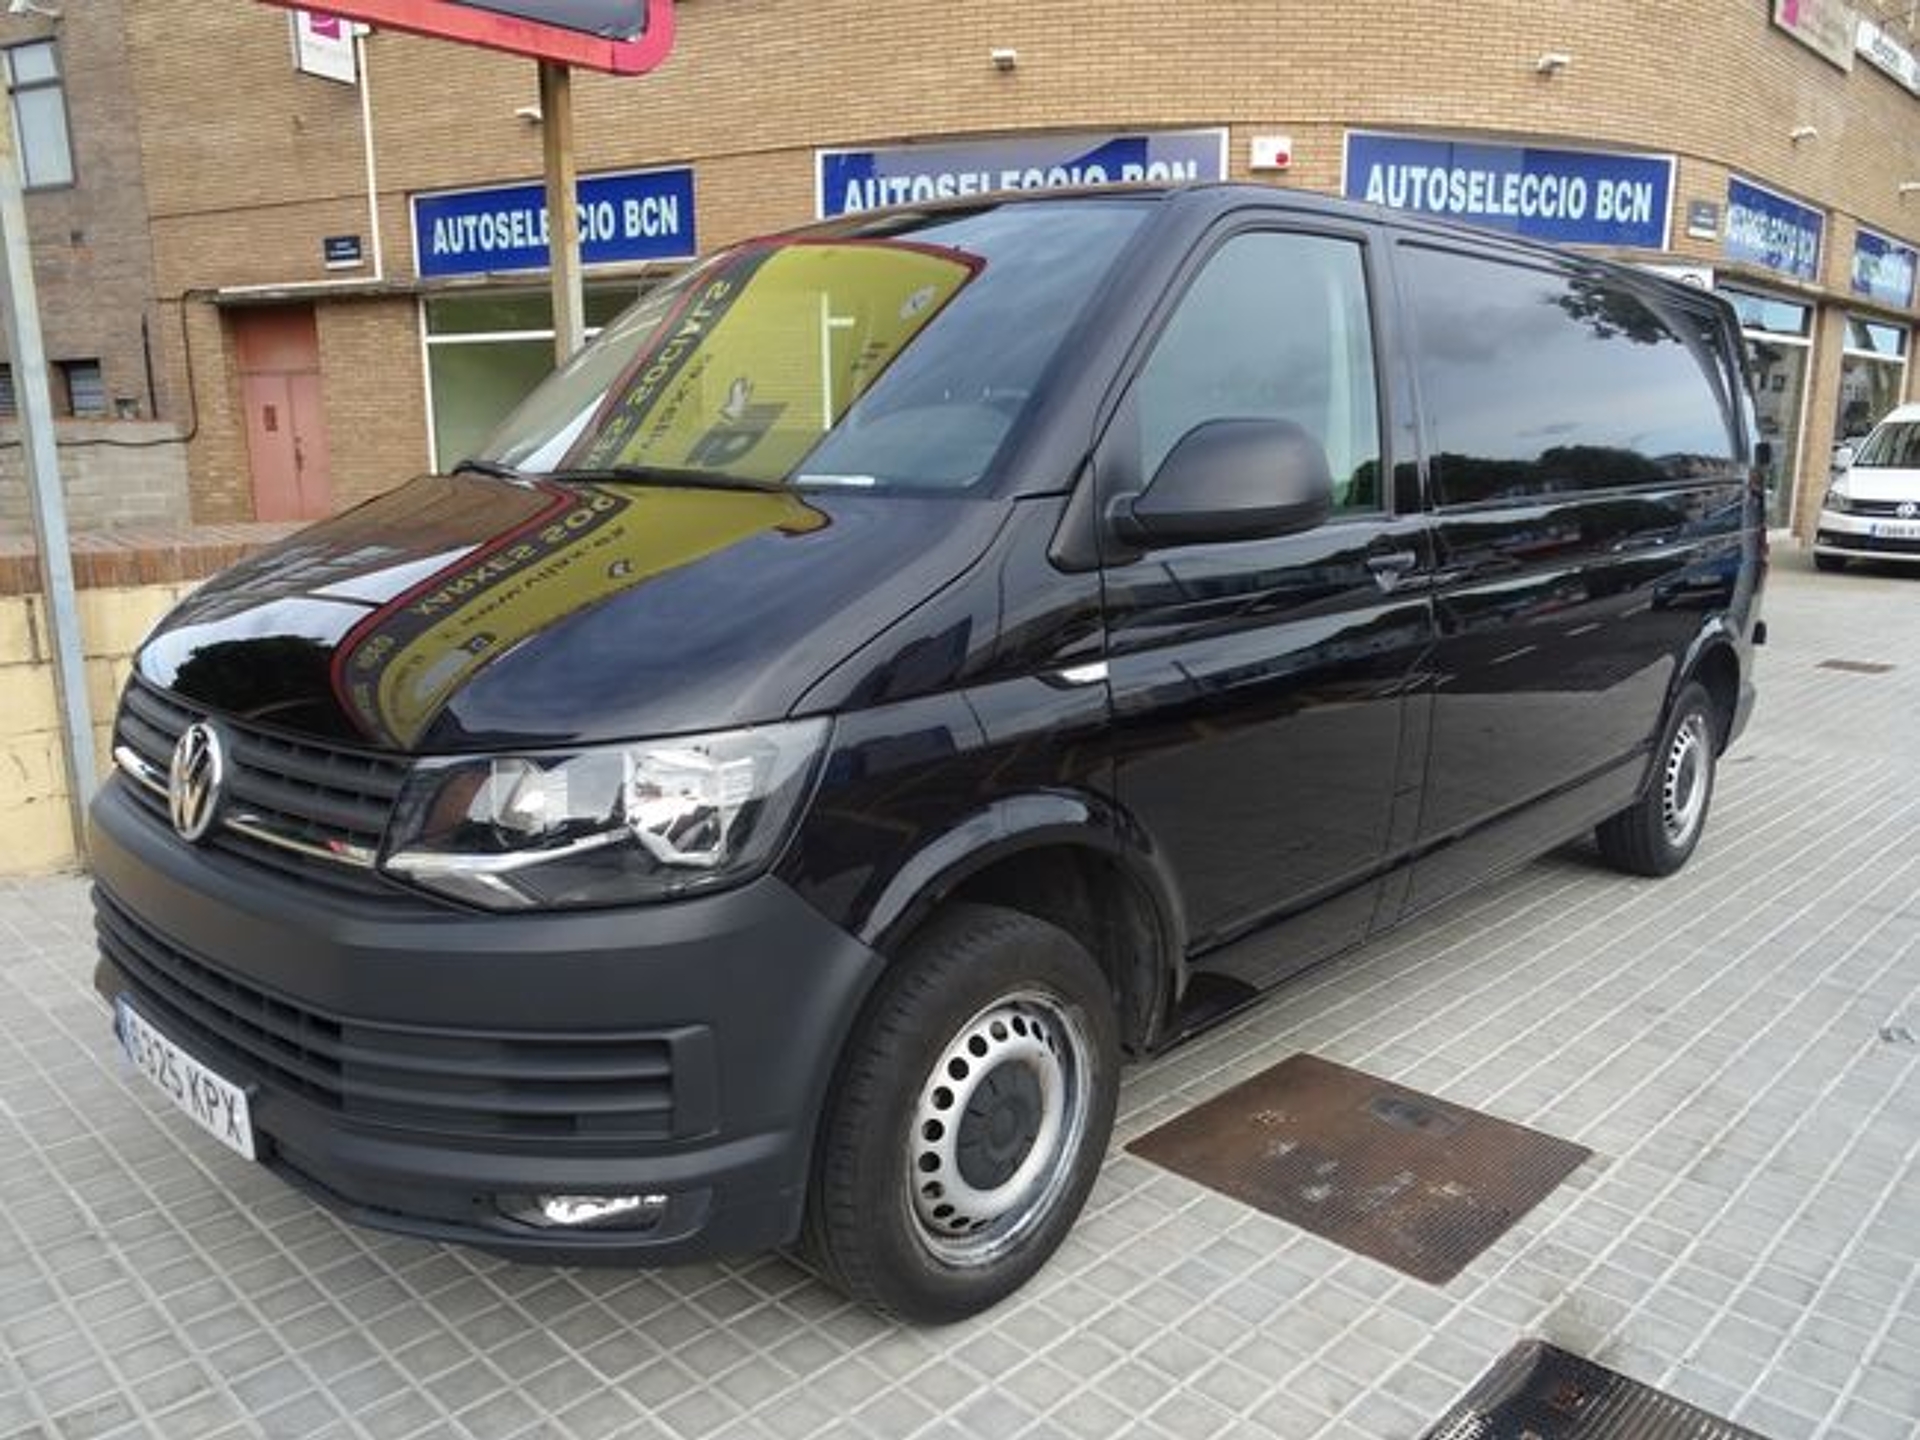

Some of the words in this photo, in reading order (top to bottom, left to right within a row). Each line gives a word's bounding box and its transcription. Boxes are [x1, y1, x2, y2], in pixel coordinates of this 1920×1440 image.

[1365, 164, 1587, 220] AUTOSELECCIO
[1594, 180, 1652, 223] BCN
[433, 202, 616, 255] AUTOSELECIO
[623, 195, 679, 237] BCN
[186, 1064, 246, 1146] KPX
